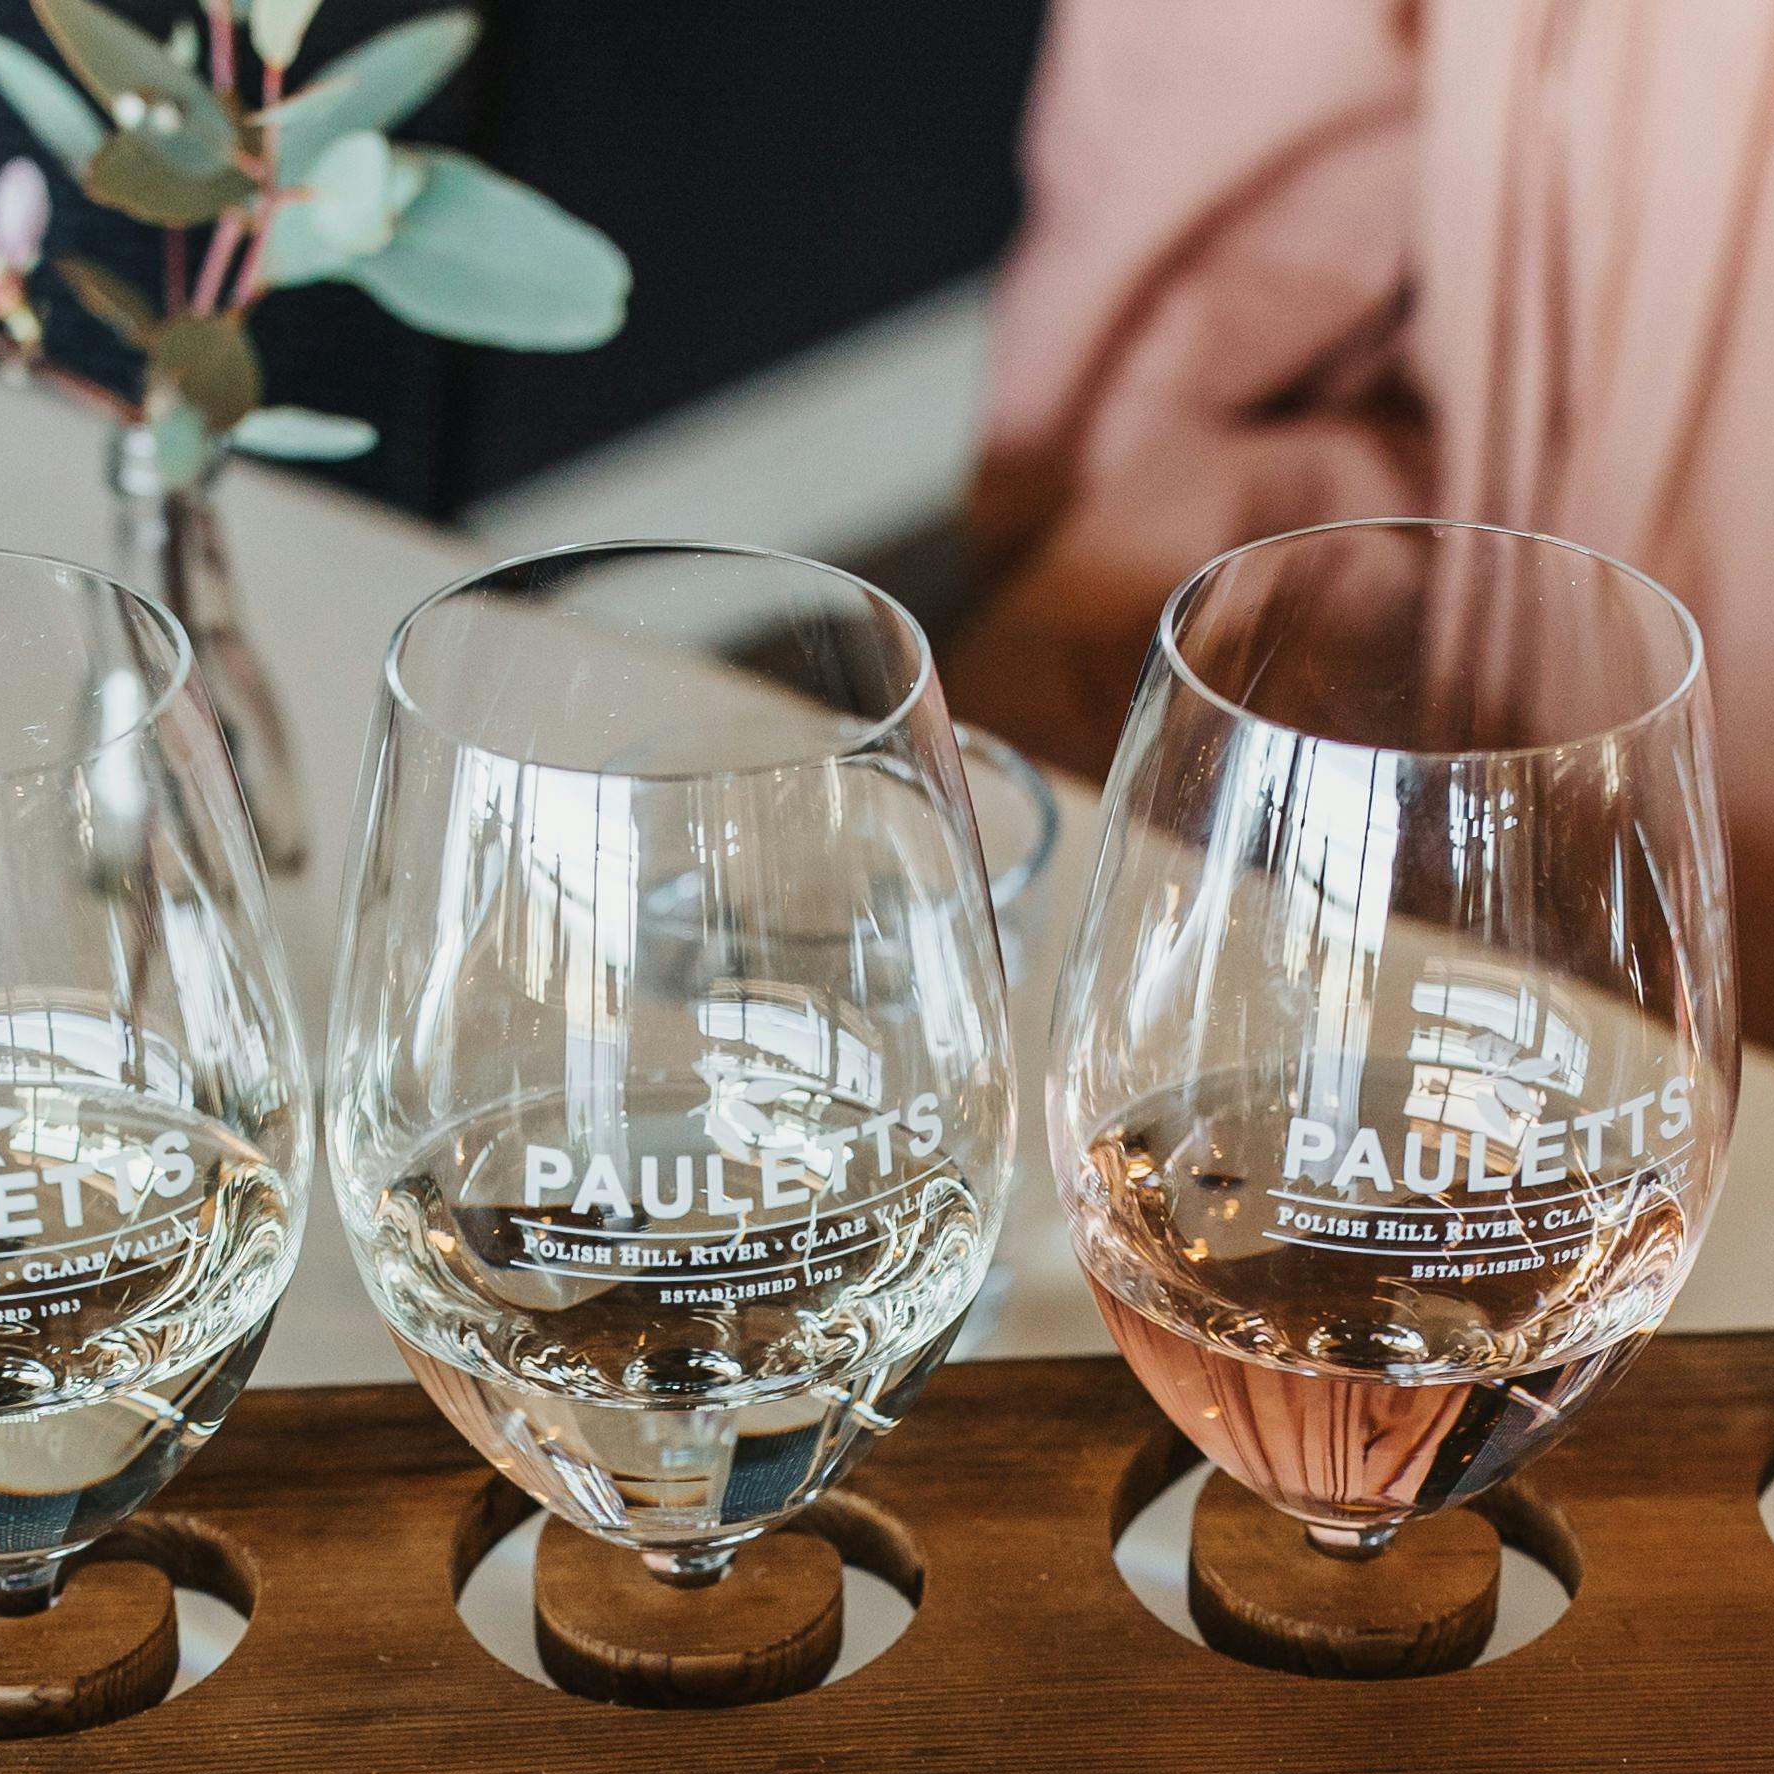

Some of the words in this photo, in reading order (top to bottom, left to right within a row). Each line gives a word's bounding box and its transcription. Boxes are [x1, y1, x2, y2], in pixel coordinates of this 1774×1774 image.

[525, 1092, 943, 1220] PAULETTS
[1283, 1075, 1691, 1193] PAULETTS
[524, 1234, 612, 1265] POLISH
[620, 1246, 682, 1267] HILL
[690, 1242, 769, 1266] RIVER
[791, 1216, 867, 1251] CLARE
[1277, 1206, 1368, 1239] POLISH
[1375, 1220, 1438, 1241] HILL
[1444, 1219, 1523, 1241] RIVER
[22, 1252, 106, 1282] CLARE
[111, 1217, 200, 1262] VALLEY
[1411, 1255, 1545, 1279] ESTABLISHED
[660, 1277, 796, 1303] ESTABLISHED
[806, 1265, 843, 1286] 1983
[41, 1299, 81, 1317] 1983
